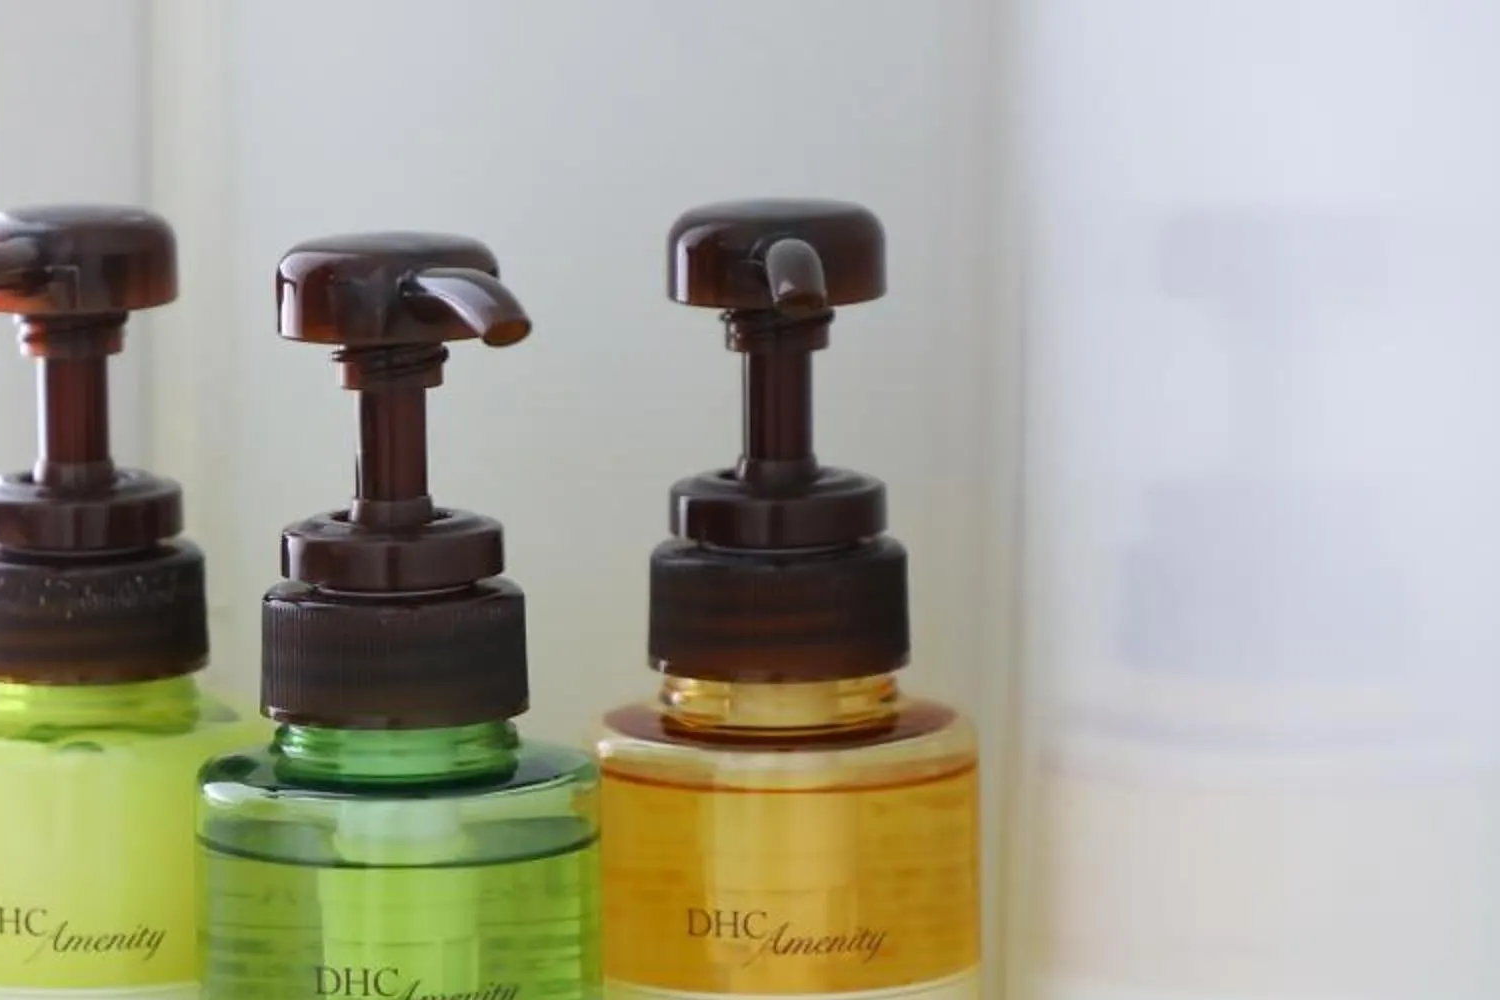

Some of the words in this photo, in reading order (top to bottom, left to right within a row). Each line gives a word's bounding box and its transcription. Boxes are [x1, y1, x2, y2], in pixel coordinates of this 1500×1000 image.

[22, 920, 167, 964] Amenity
[687, 908, 768, 941] DHC
[742, 922, 887, 967] Amenity
[315, 966, 398, 998] DHC
